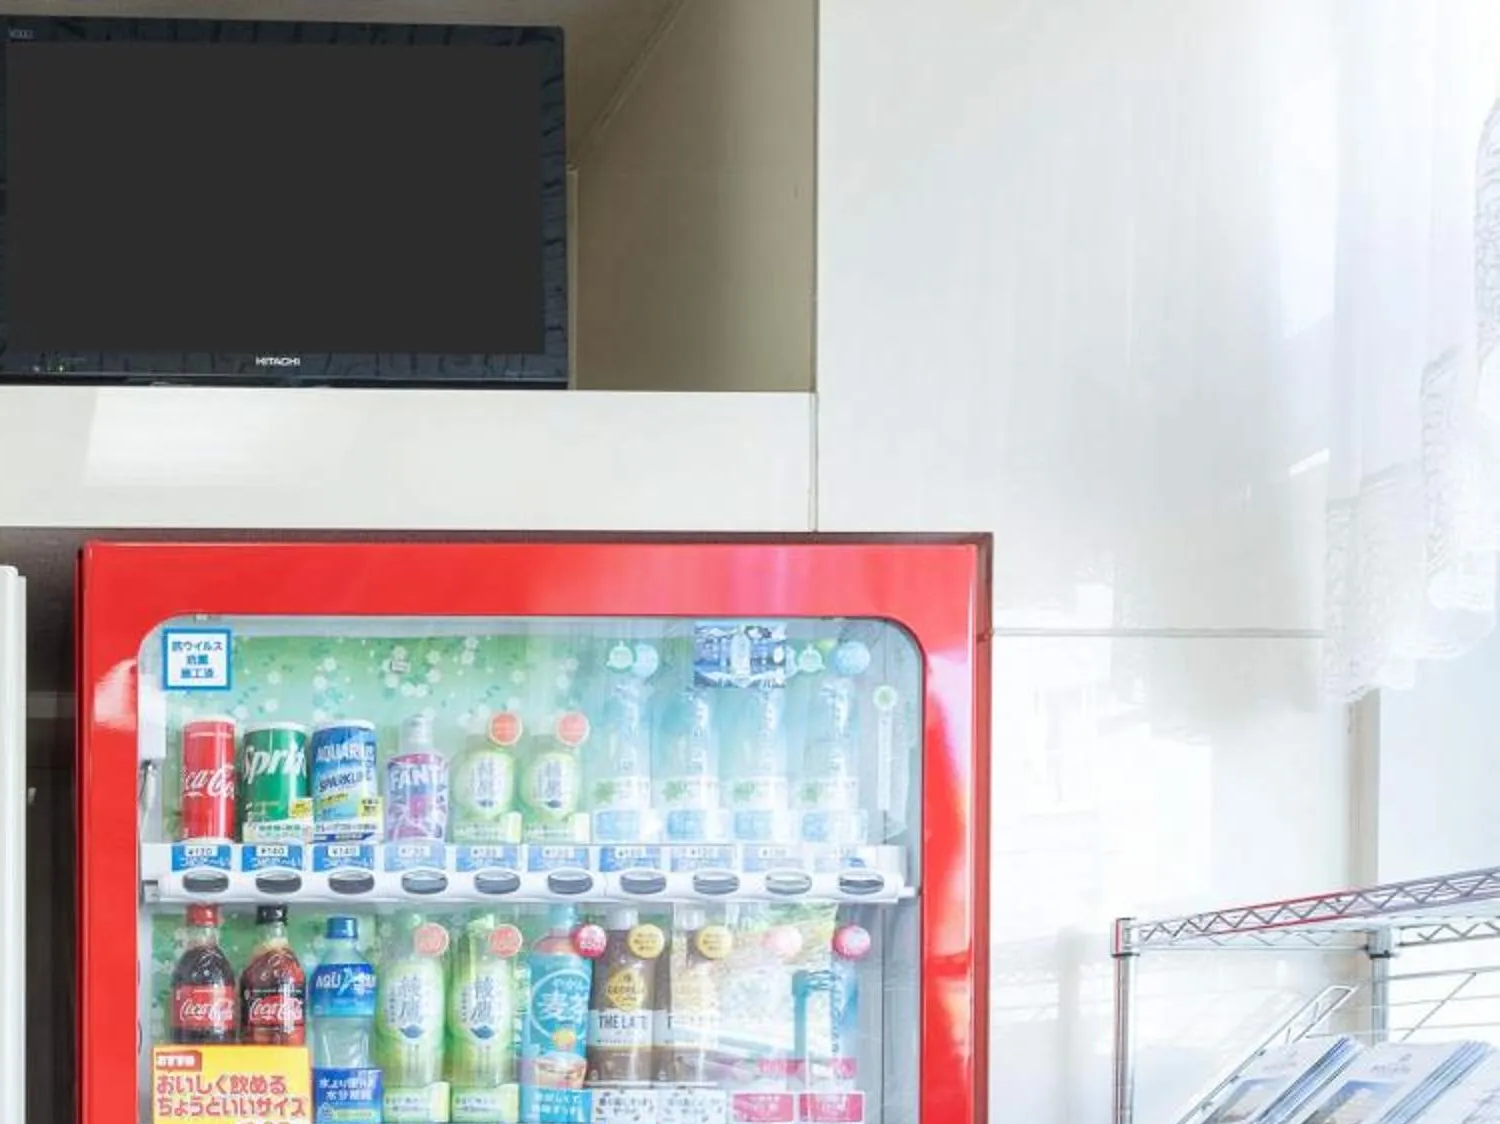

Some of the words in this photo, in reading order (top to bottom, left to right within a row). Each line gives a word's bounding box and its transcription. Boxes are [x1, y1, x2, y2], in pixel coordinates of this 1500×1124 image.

[256, 357, 301, 367] HITACHI
[156, 1075, 287, 1095] おいしく飲める
[157, 1097, 306, 1117] ちょうどいいサイズ
